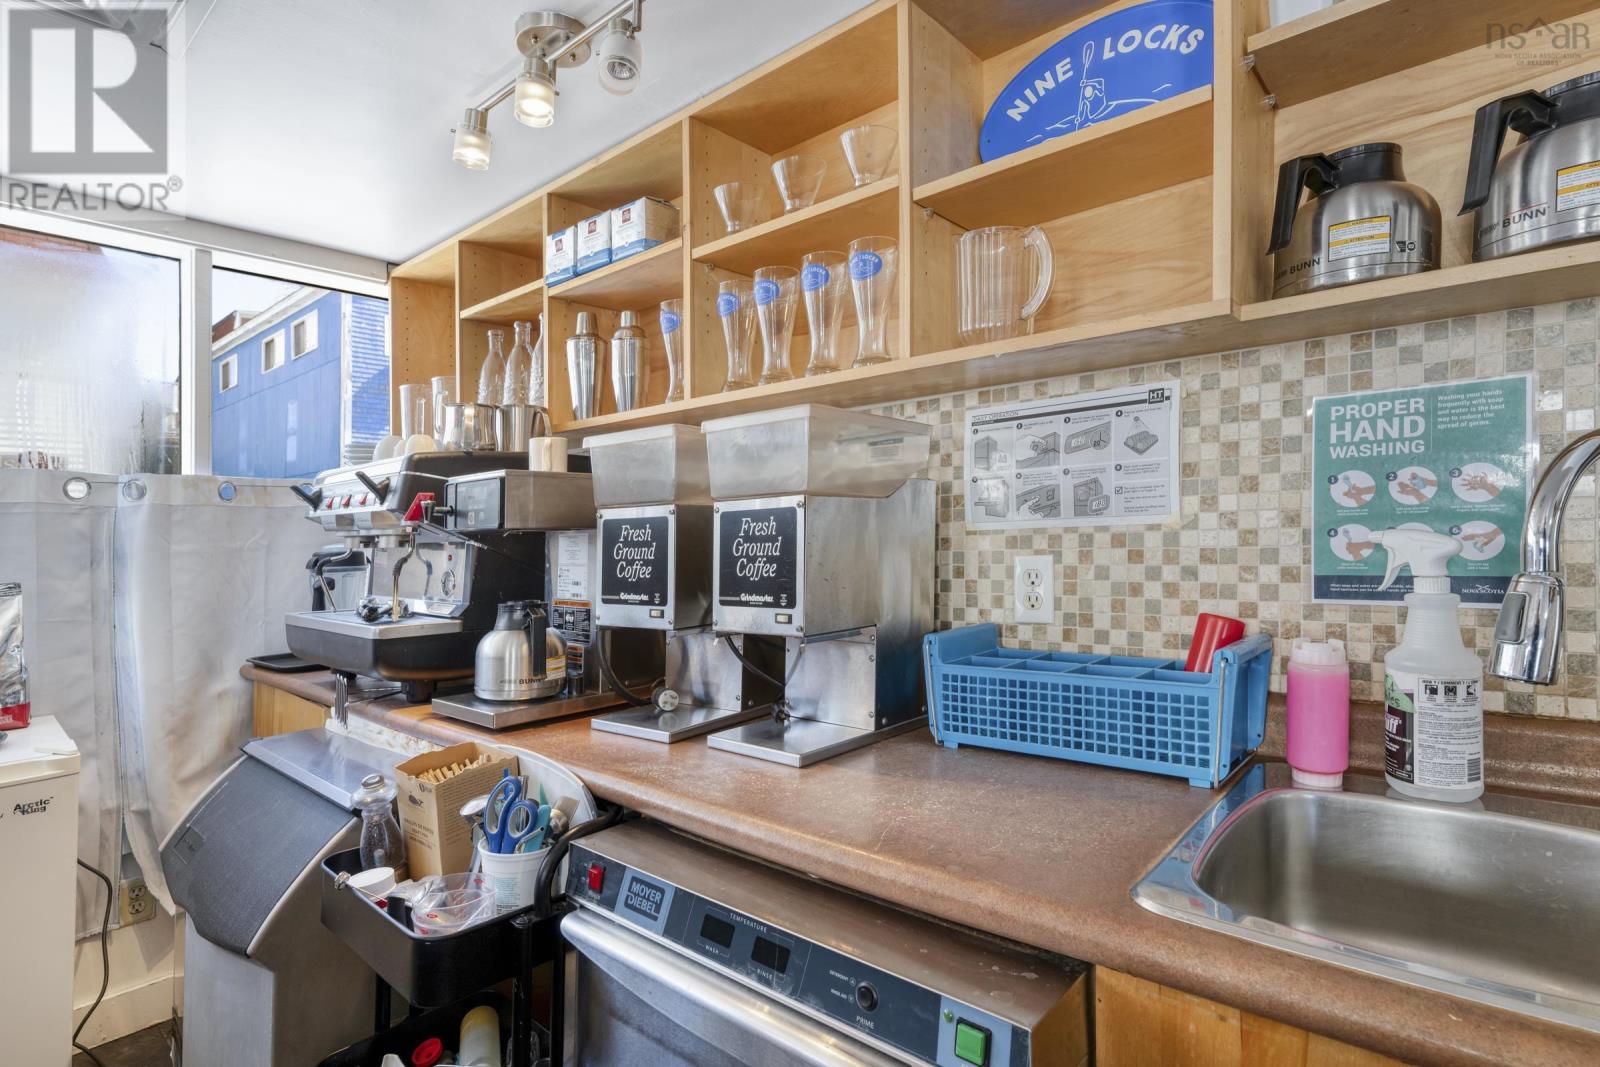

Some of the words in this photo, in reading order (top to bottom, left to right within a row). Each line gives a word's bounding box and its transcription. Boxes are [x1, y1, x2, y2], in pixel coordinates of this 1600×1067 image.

[1006, 57, 1074, 122] NINE
[1102, 23, 1205, 60] LOCKS
[1503, 207, 1547, 228] BUNN
[1289, 257, 1321, 275] BUNN
[1330, 397, 1425, 421] PROPER
[1330, 415, 1426, 444] HAND
[1329, 440, 1425, 459] WASHING
[619, 523, 652, 542] Fresh
[739, 516, 777, 536] Fresh
[613, 542, 656, 560] Ground
[732, 536, 782, 556] Ground
[616, 561, 653, 582] Coffee
[736, 557, 777, 581] Coffee
[13, 798, 51, 812] Arctic
[21, 805, 47, 816] King
[631, 881, 662, 904] MOYER
[627, 893, 660, 917] DIEBEL
[729, 912, 767, 933] TEMPERATURE
[705, 944, 719, 954] WASH
[757, 968, 773, 980] RINSE
[856, 1015, 875, 1029] PRIME
